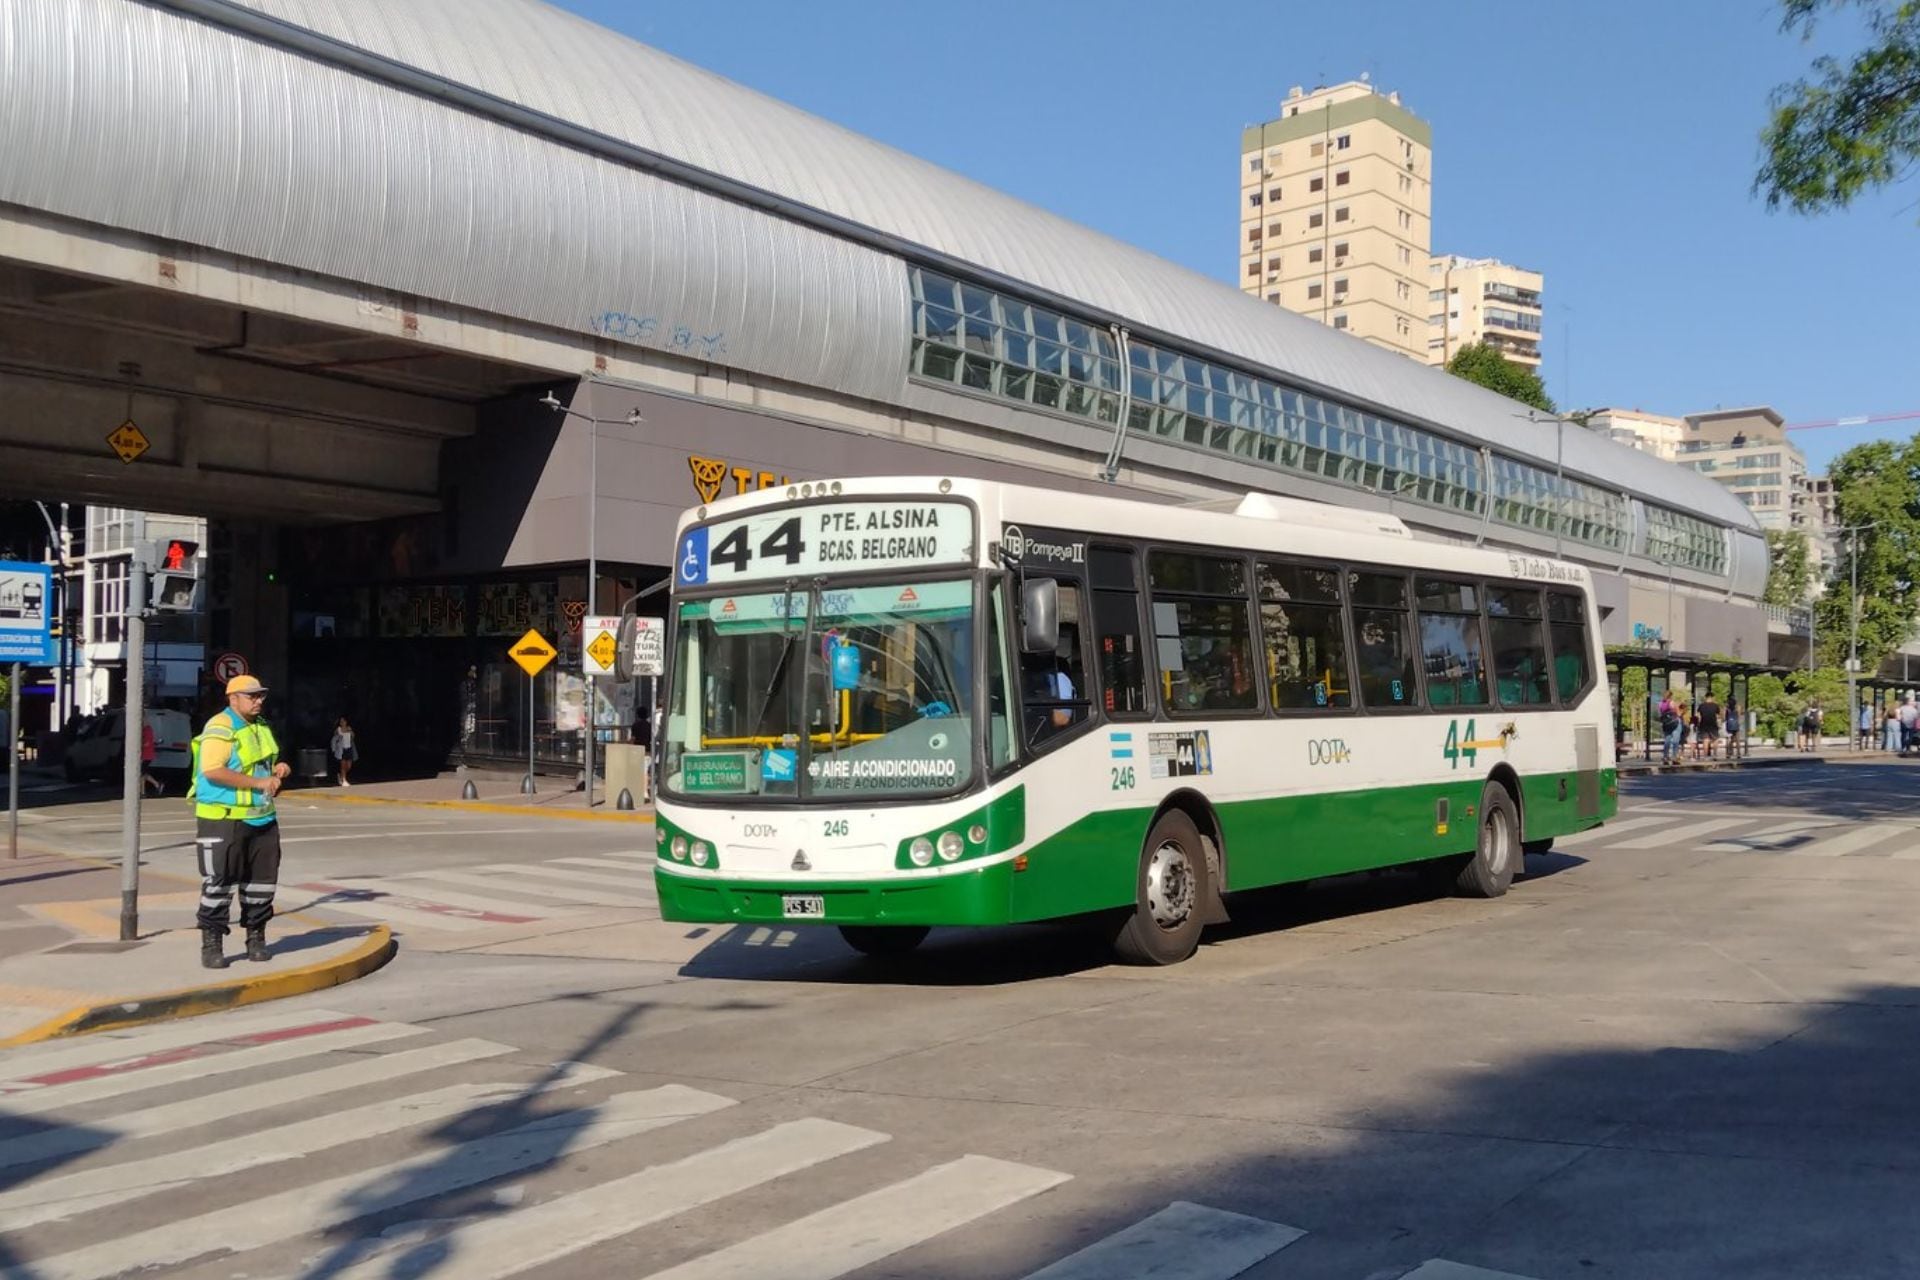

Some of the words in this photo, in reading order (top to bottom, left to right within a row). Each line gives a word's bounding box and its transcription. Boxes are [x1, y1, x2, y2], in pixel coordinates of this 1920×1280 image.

[820, 511, 860, 532] PTE.
[865, 508, 939, 530] ALSINA
[710, 516, 806, 573] 44
[819, 540, 857, 562] BCAS.
[861, 536, 937, 560] BELGRANO
[1178, 744, 1194, 766] 44
[1308, 738, 1350, 766] DOTA
[1443, 718, 1477, 770] 44
[822, 760, 849, 777] AIRE
[852, 758, 956, 777] ACONDICIONADO
[1111, 766, 1135, 790] 246
[823, 820, 849, 837] 246
